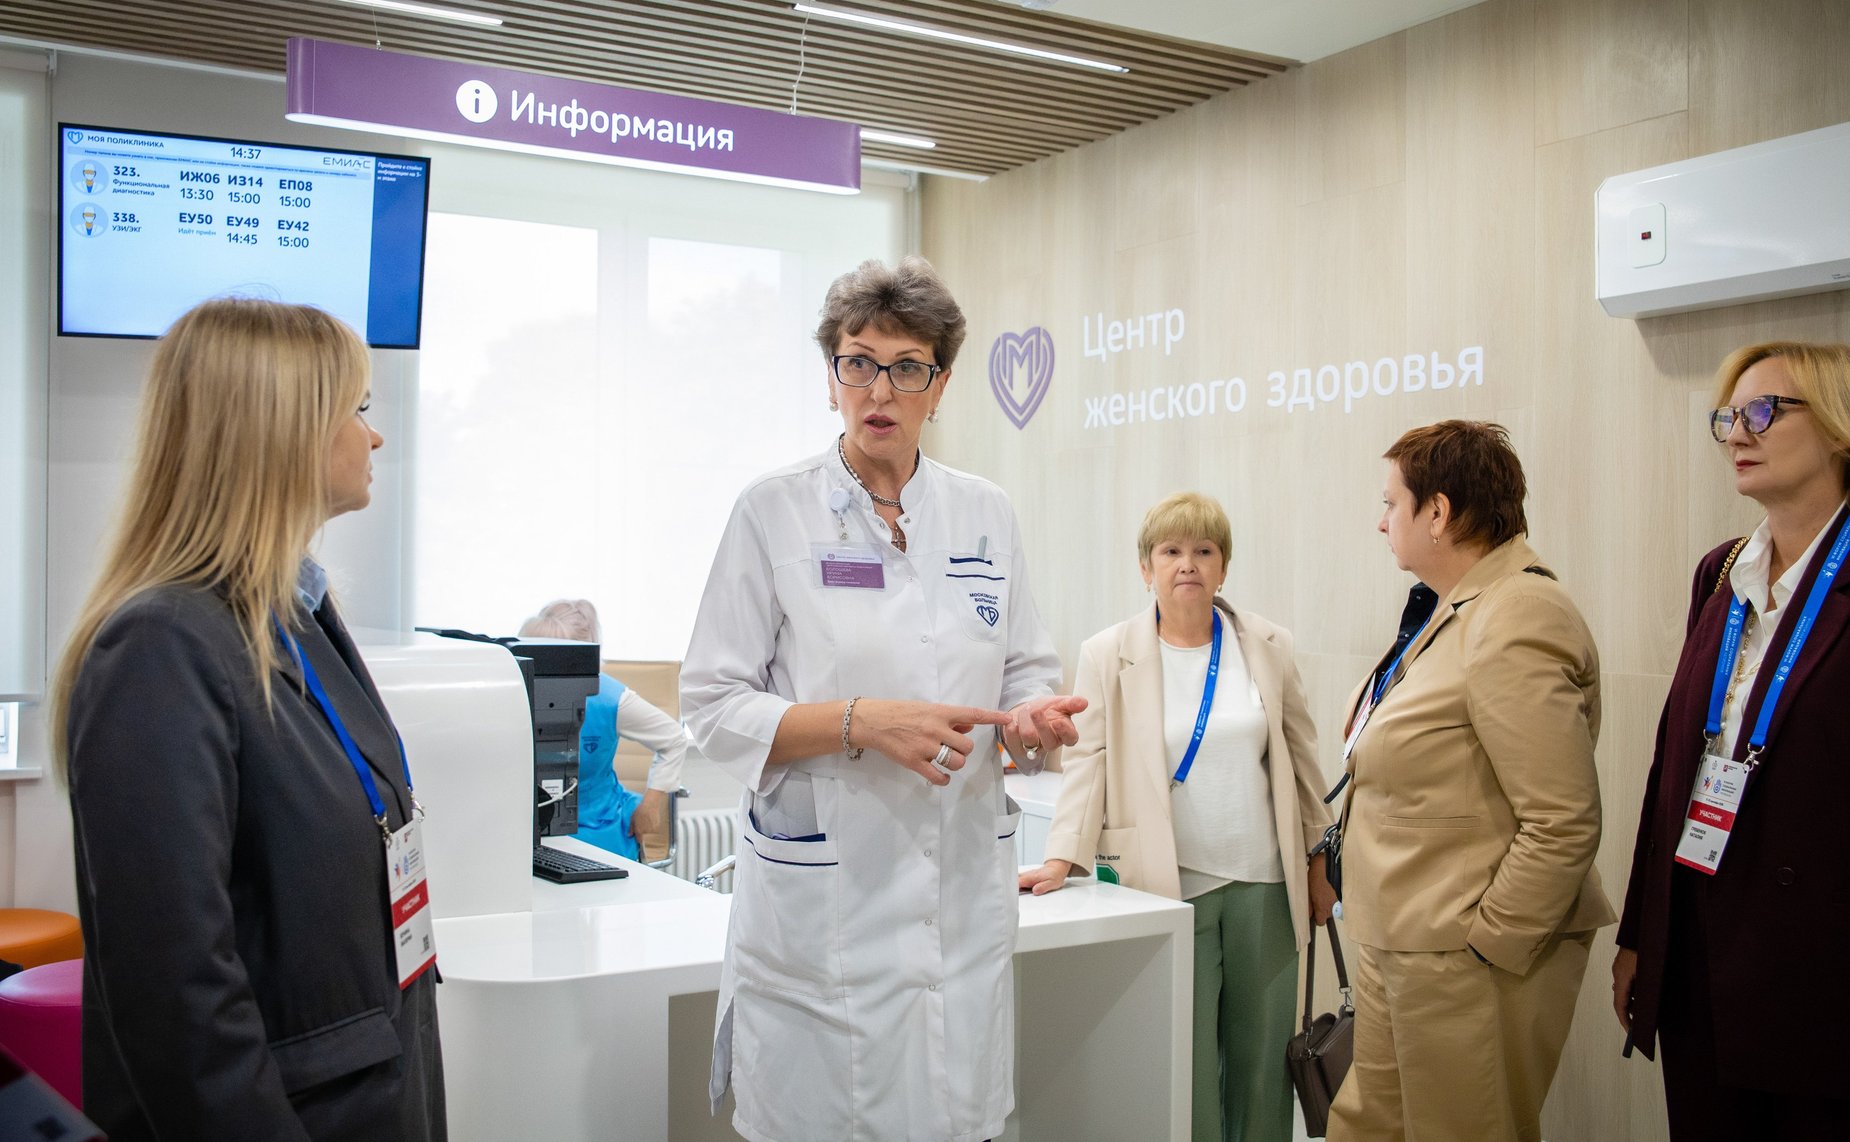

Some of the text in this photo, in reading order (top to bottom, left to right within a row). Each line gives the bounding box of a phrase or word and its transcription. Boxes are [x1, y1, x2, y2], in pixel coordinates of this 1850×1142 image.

[511, 89, 734, 151] Информация
[87, 135, 164, 148] МОЯ ПОЛИКЛИНИКА
[230, 146, 262, 160] 14:37
[323, 156, 371, 169] ЕМИАС
[113, 166, 141, 177] 323.
[180, 170, 221, 184] ИЖ06
[112, 178, 170, 189] Функциональная
[228, 174, 263, 187] ИЗ14
[279, 179, 313, 192] ЕП08
[112, 187, 155, 196] диагностика
[180, 188, 214, 201] 13:30
[228, 192, 261, 204] 15:00
[279, 196, 311, 208] 15:00
[113, 212, 140, 224] 338.
[179, 212, 213, 225] ЕУ50
[226, 216, 260, 228] ЕУ49
[112, 224, 142, 233] УЗИ/ЭКГ
[277, 219, 310, 232] ЕУ42
[226, 232, 258, 245] 14:45
[277, 236, 310, 248] 15:00
[1083, 307, 1185, 363] Центр
[1083, 346, 1484, 430] женского здоровья
[1699, 809, 1723, 822] УЧАСТНИК
